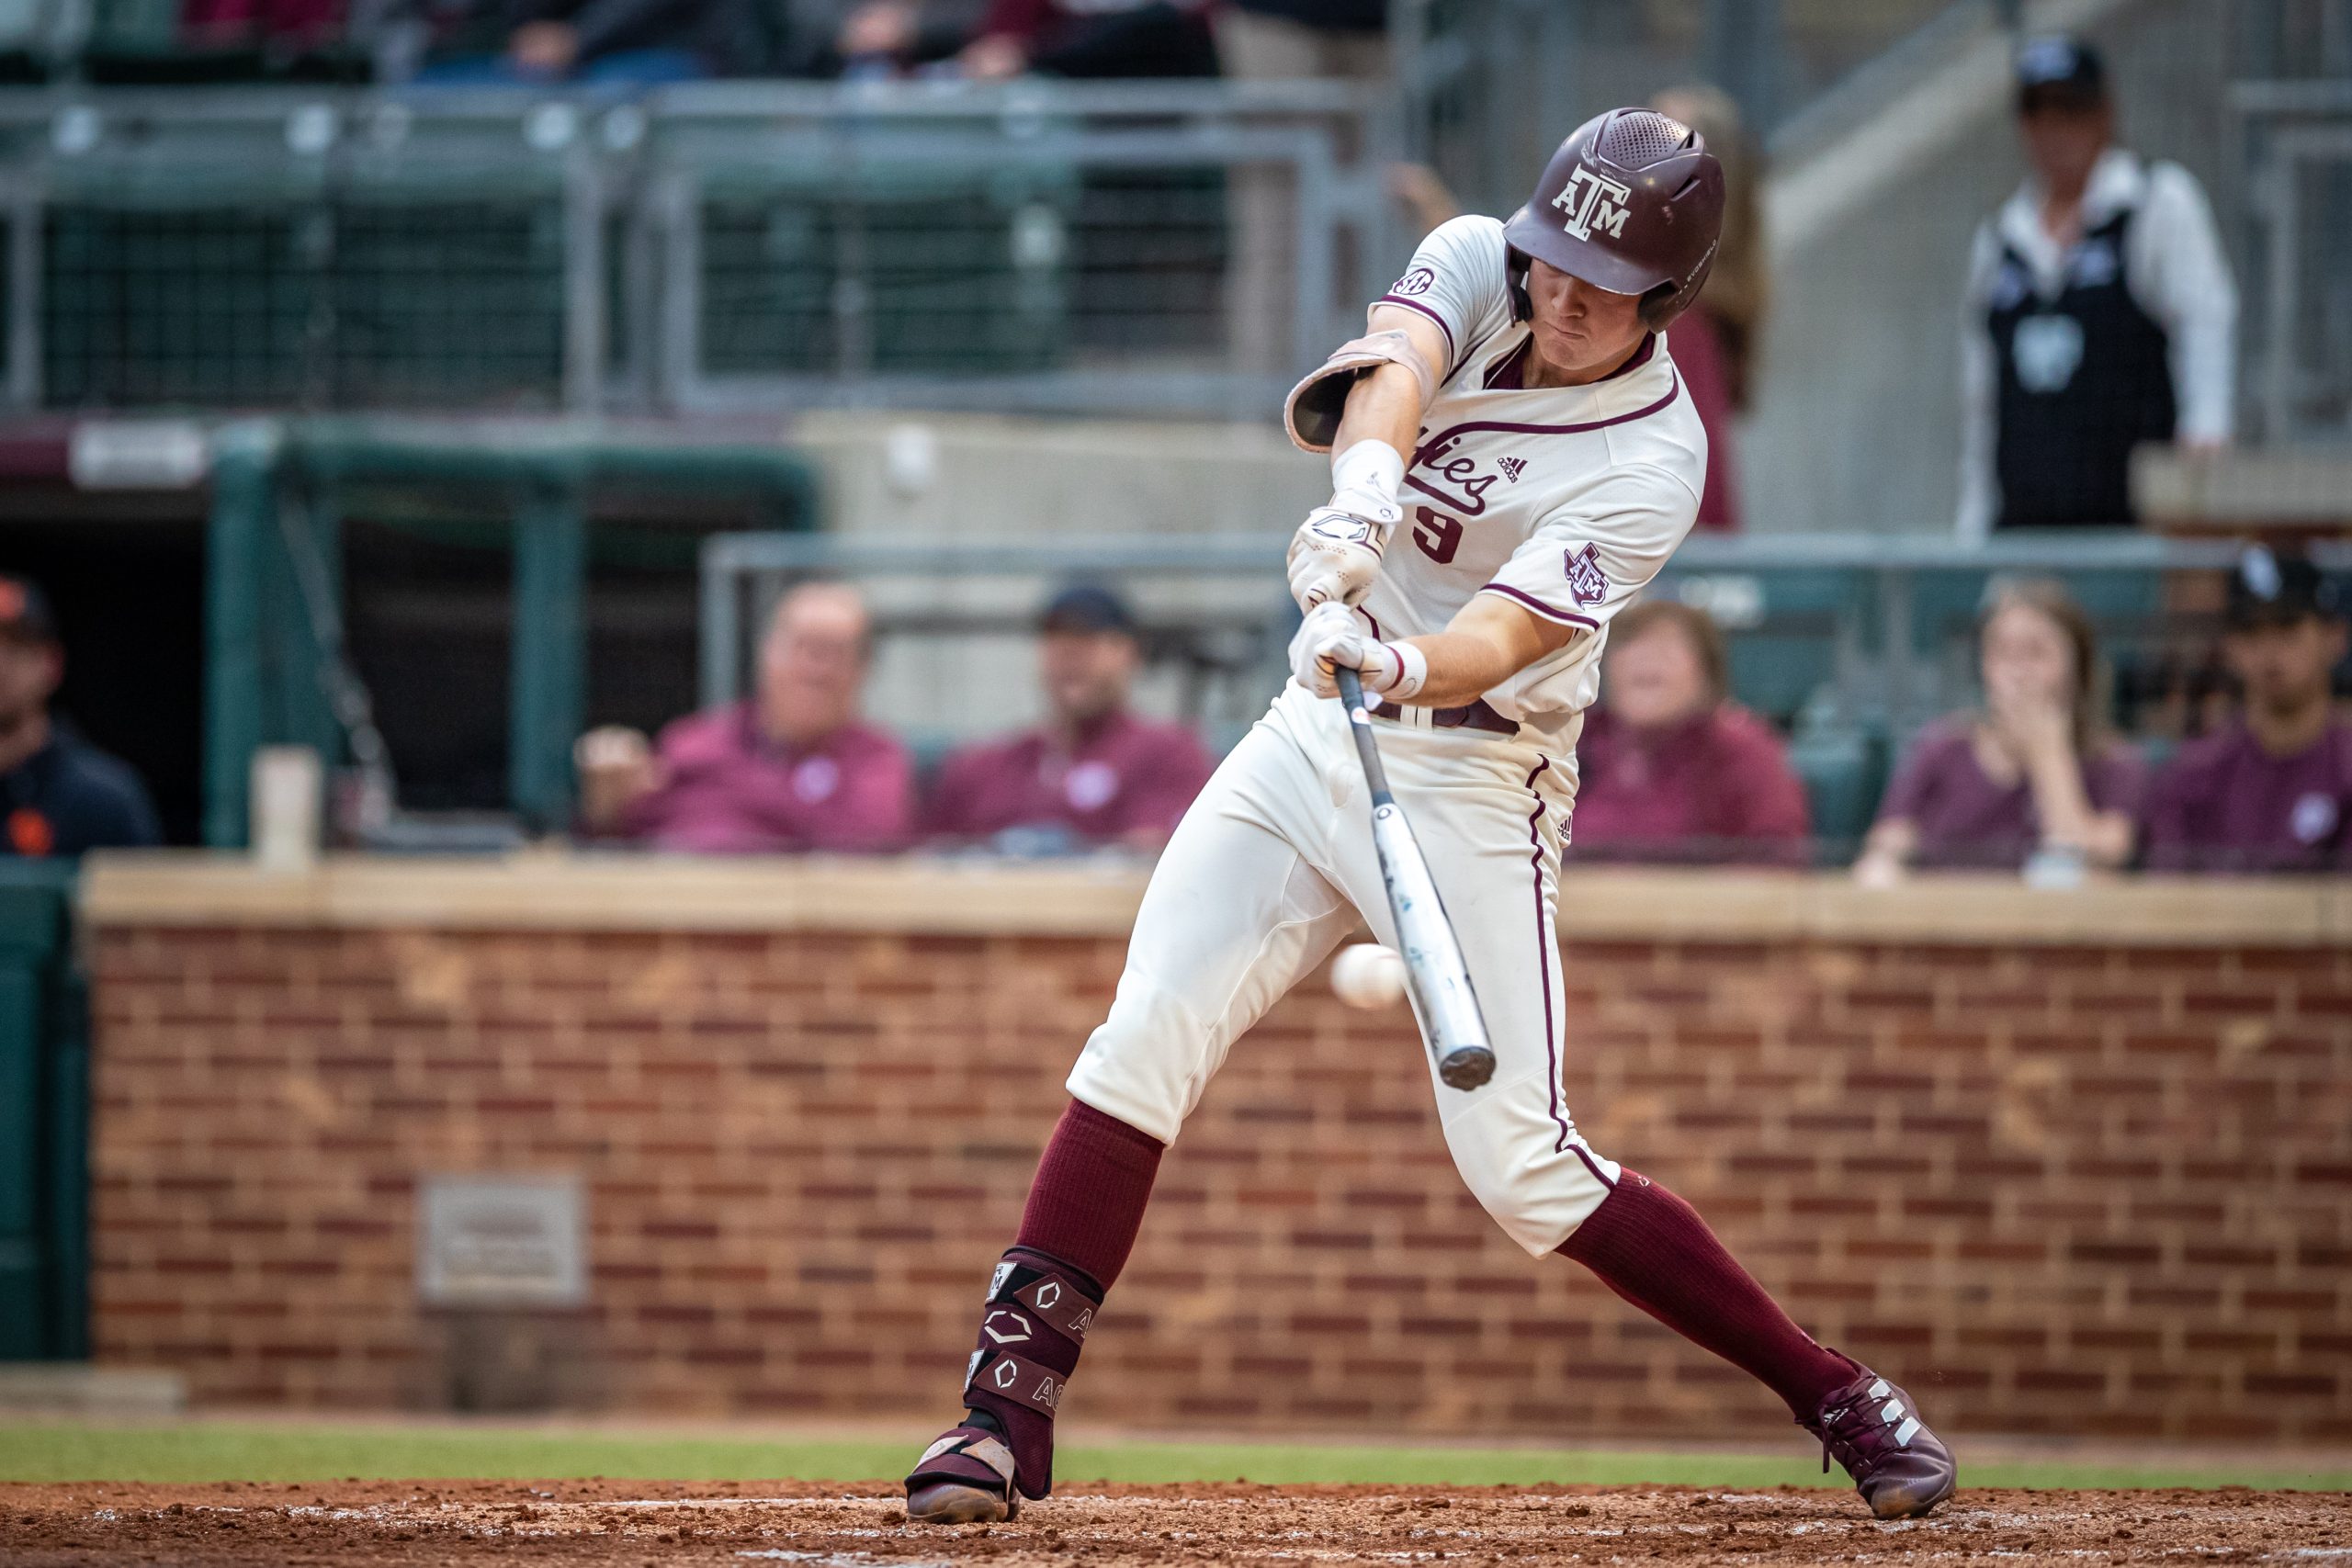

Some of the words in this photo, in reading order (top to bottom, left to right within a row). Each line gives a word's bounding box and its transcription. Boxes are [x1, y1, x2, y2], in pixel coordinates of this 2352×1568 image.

[1551, 163, 1632, 243] ATM
[1394, 269, 1434, 295] SEC
[1497, 457, 1518, 484] adidas
[1412, 506, 1464, 564] 9
